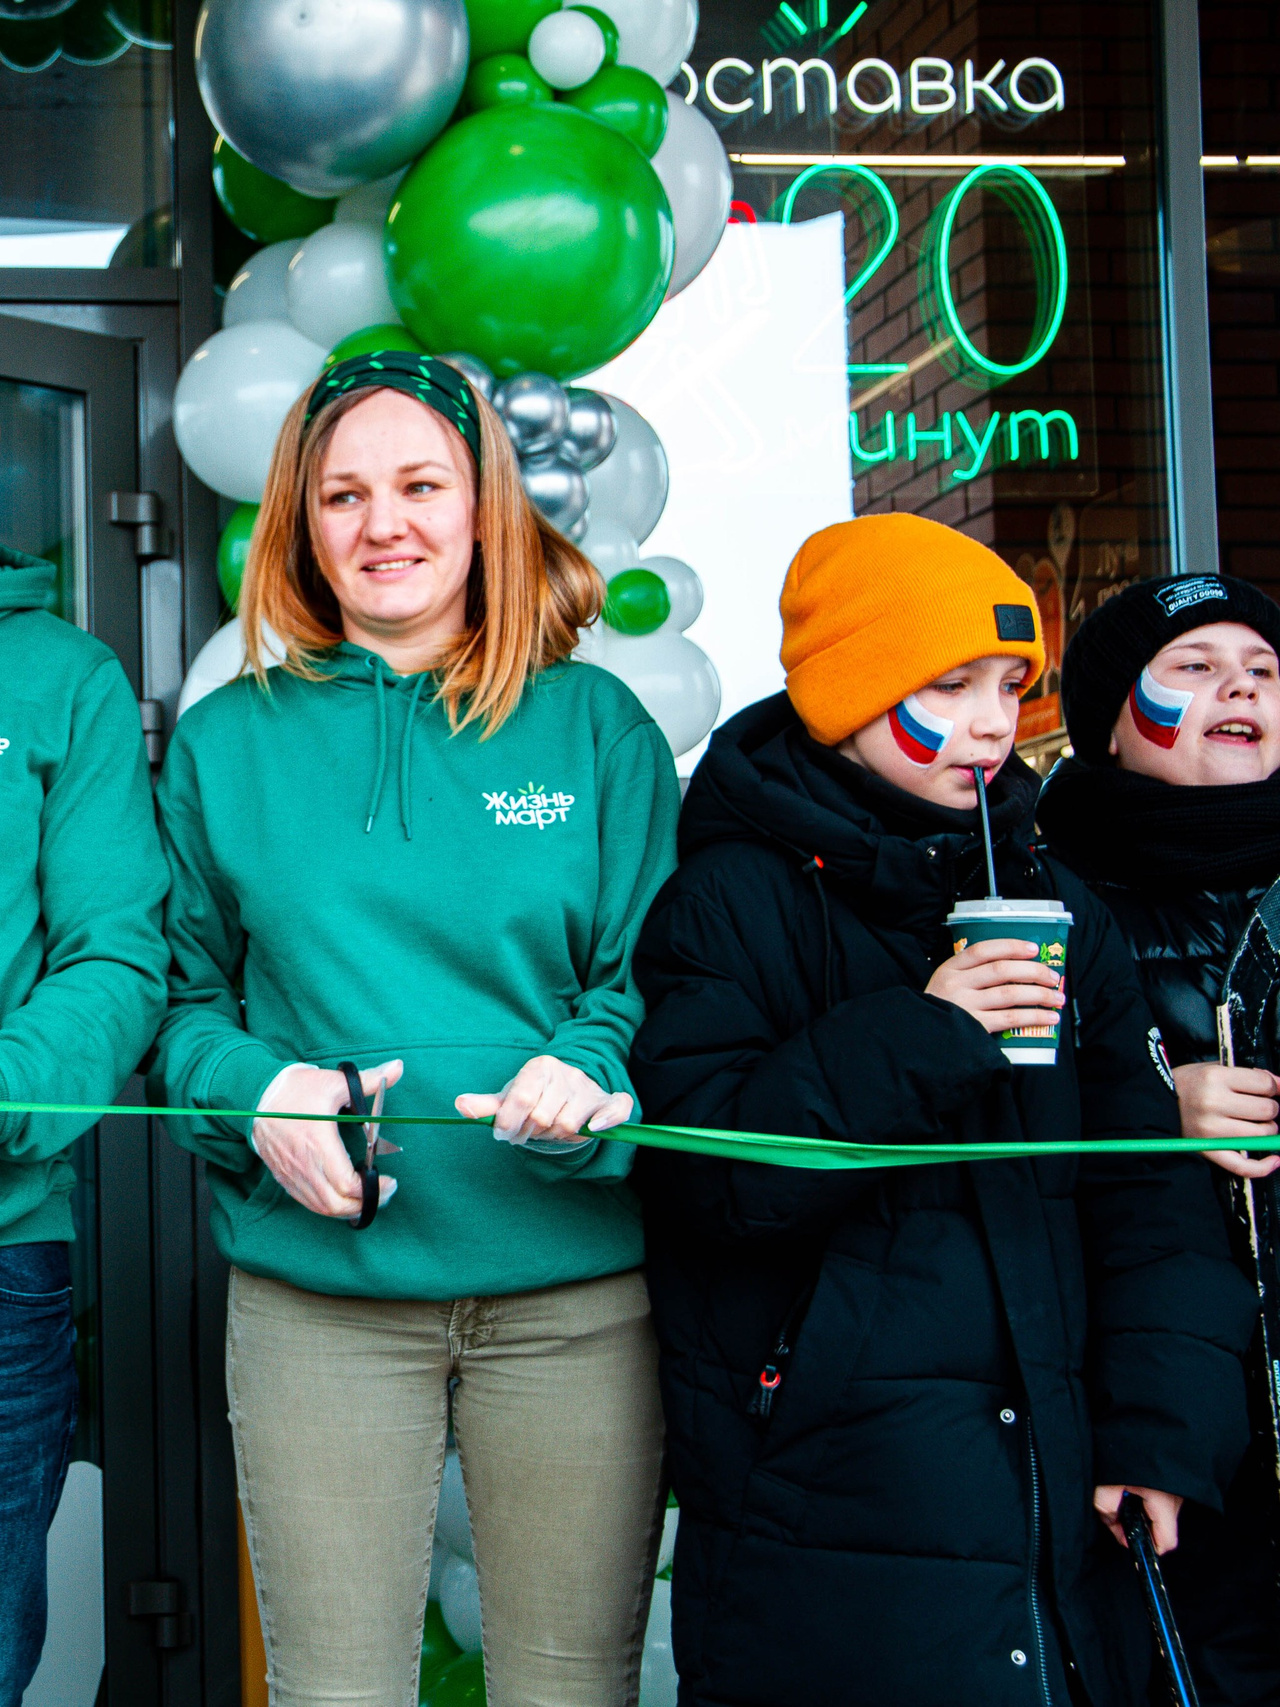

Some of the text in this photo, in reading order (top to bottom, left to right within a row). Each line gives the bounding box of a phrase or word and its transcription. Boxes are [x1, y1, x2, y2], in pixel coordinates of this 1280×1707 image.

[782, 163, 1068, 375] 20
[849, 409, 1078, 481] инут
[481, 790, 575, 811] Жизнь
[495, 807, 570, 830] март
